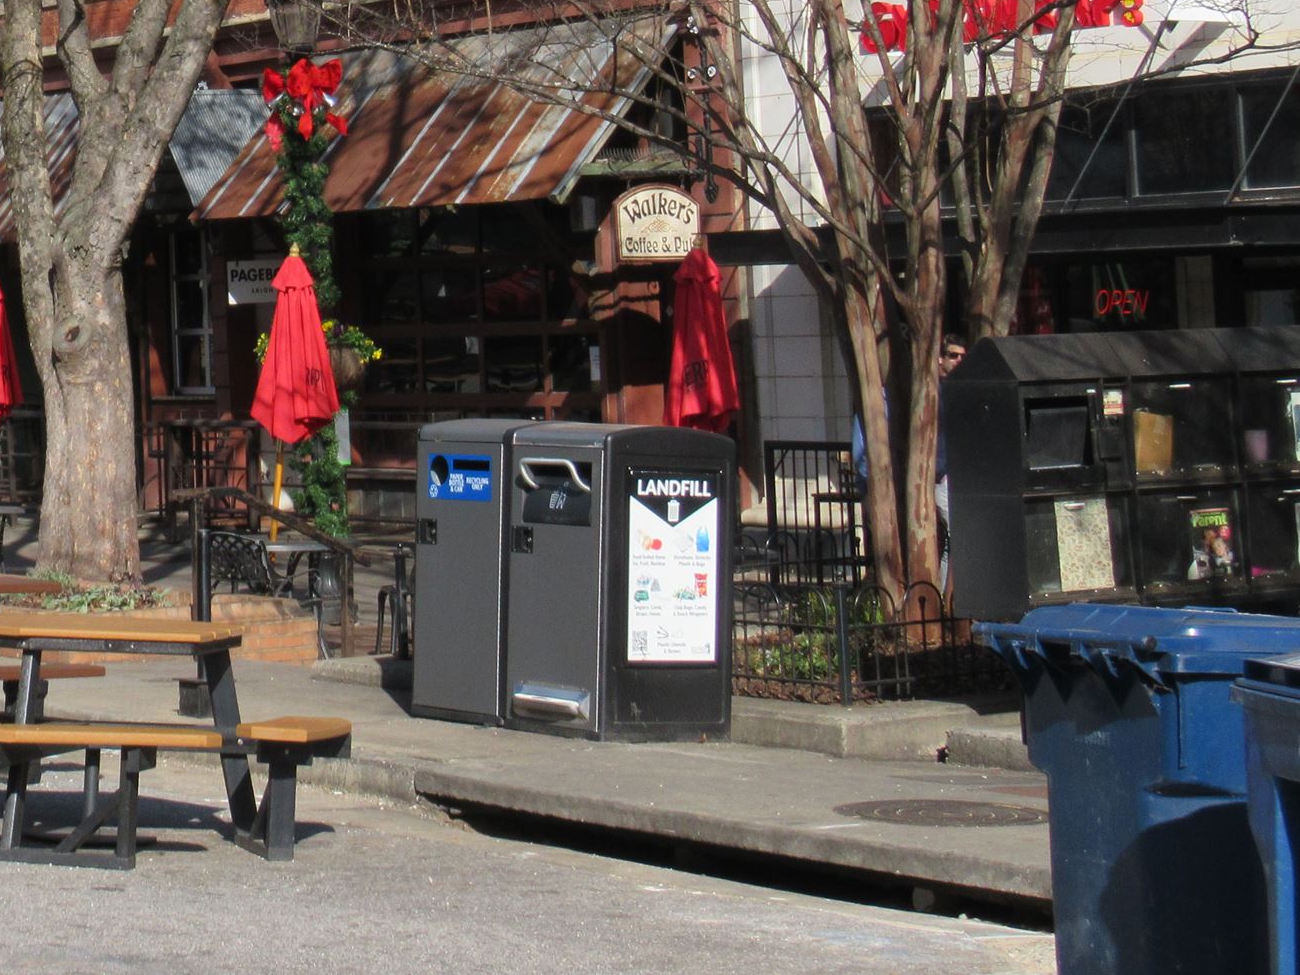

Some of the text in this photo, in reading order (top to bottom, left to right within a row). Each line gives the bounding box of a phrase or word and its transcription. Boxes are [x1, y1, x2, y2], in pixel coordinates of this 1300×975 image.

[622, 192, 695, 225] Walker's
[624, 236, 659, 254] Coffee
[662, 236, 672, 253] &
[230, 267, 279, 283] PAGEB
[1094, 289, 1149, 315] OPEN
[466, 477, 489, 485] RECYCLING
[637, 478, 712, 497] LANDFILL
